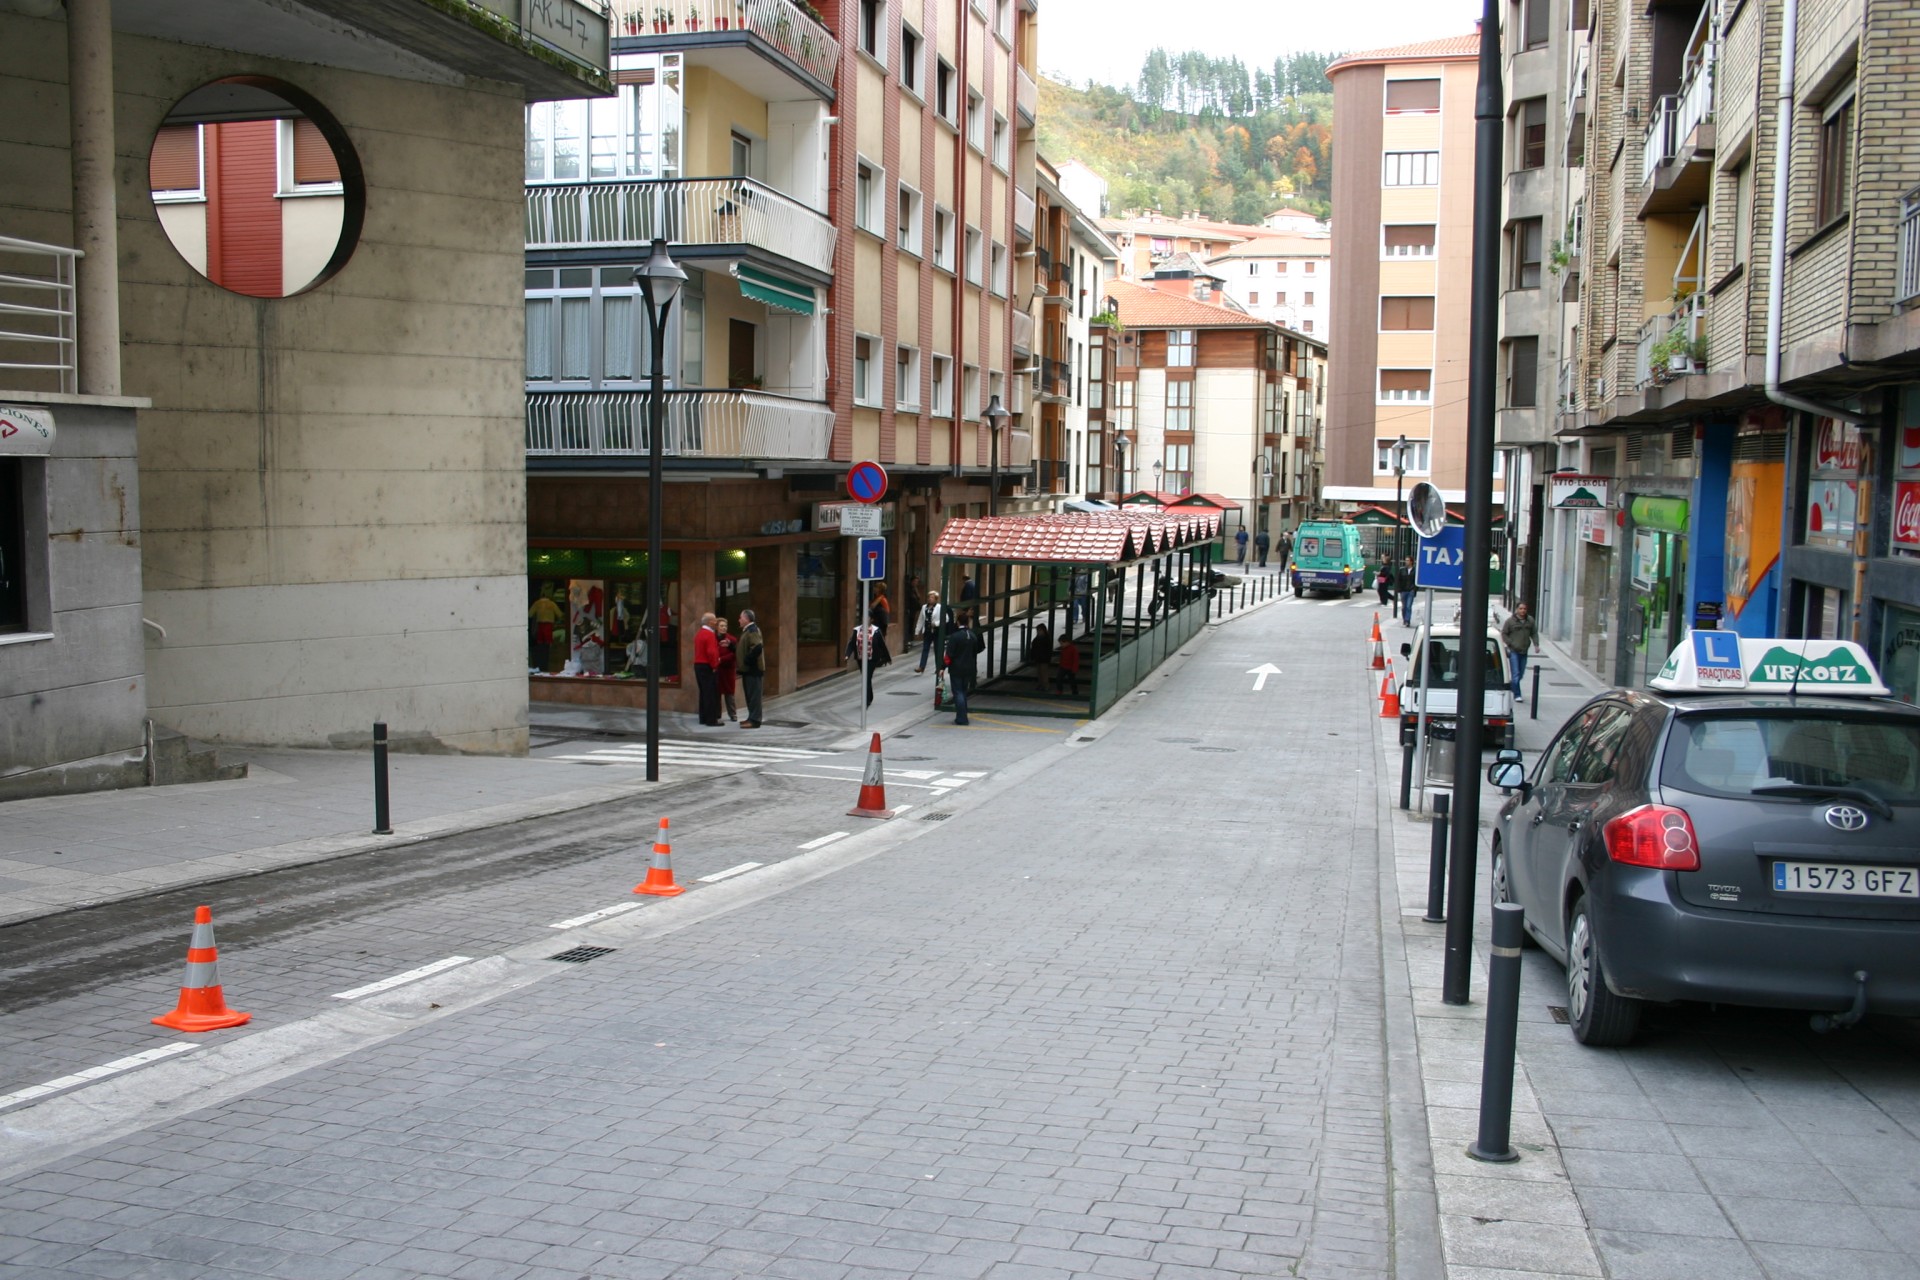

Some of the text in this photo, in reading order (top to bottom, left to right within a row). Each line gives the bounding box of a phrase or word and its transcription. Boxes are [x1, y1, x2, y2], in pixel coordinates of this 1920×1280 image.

[1422, 545, 1464, 566] TAX
[1704, 636, 1729, 663] L
[1698, 667, 1741, 680] PRACTICAS
[1708, 884, 1741, 893] TOYOTA
[1793, 867, 1913, 894] 1573 GFZ
